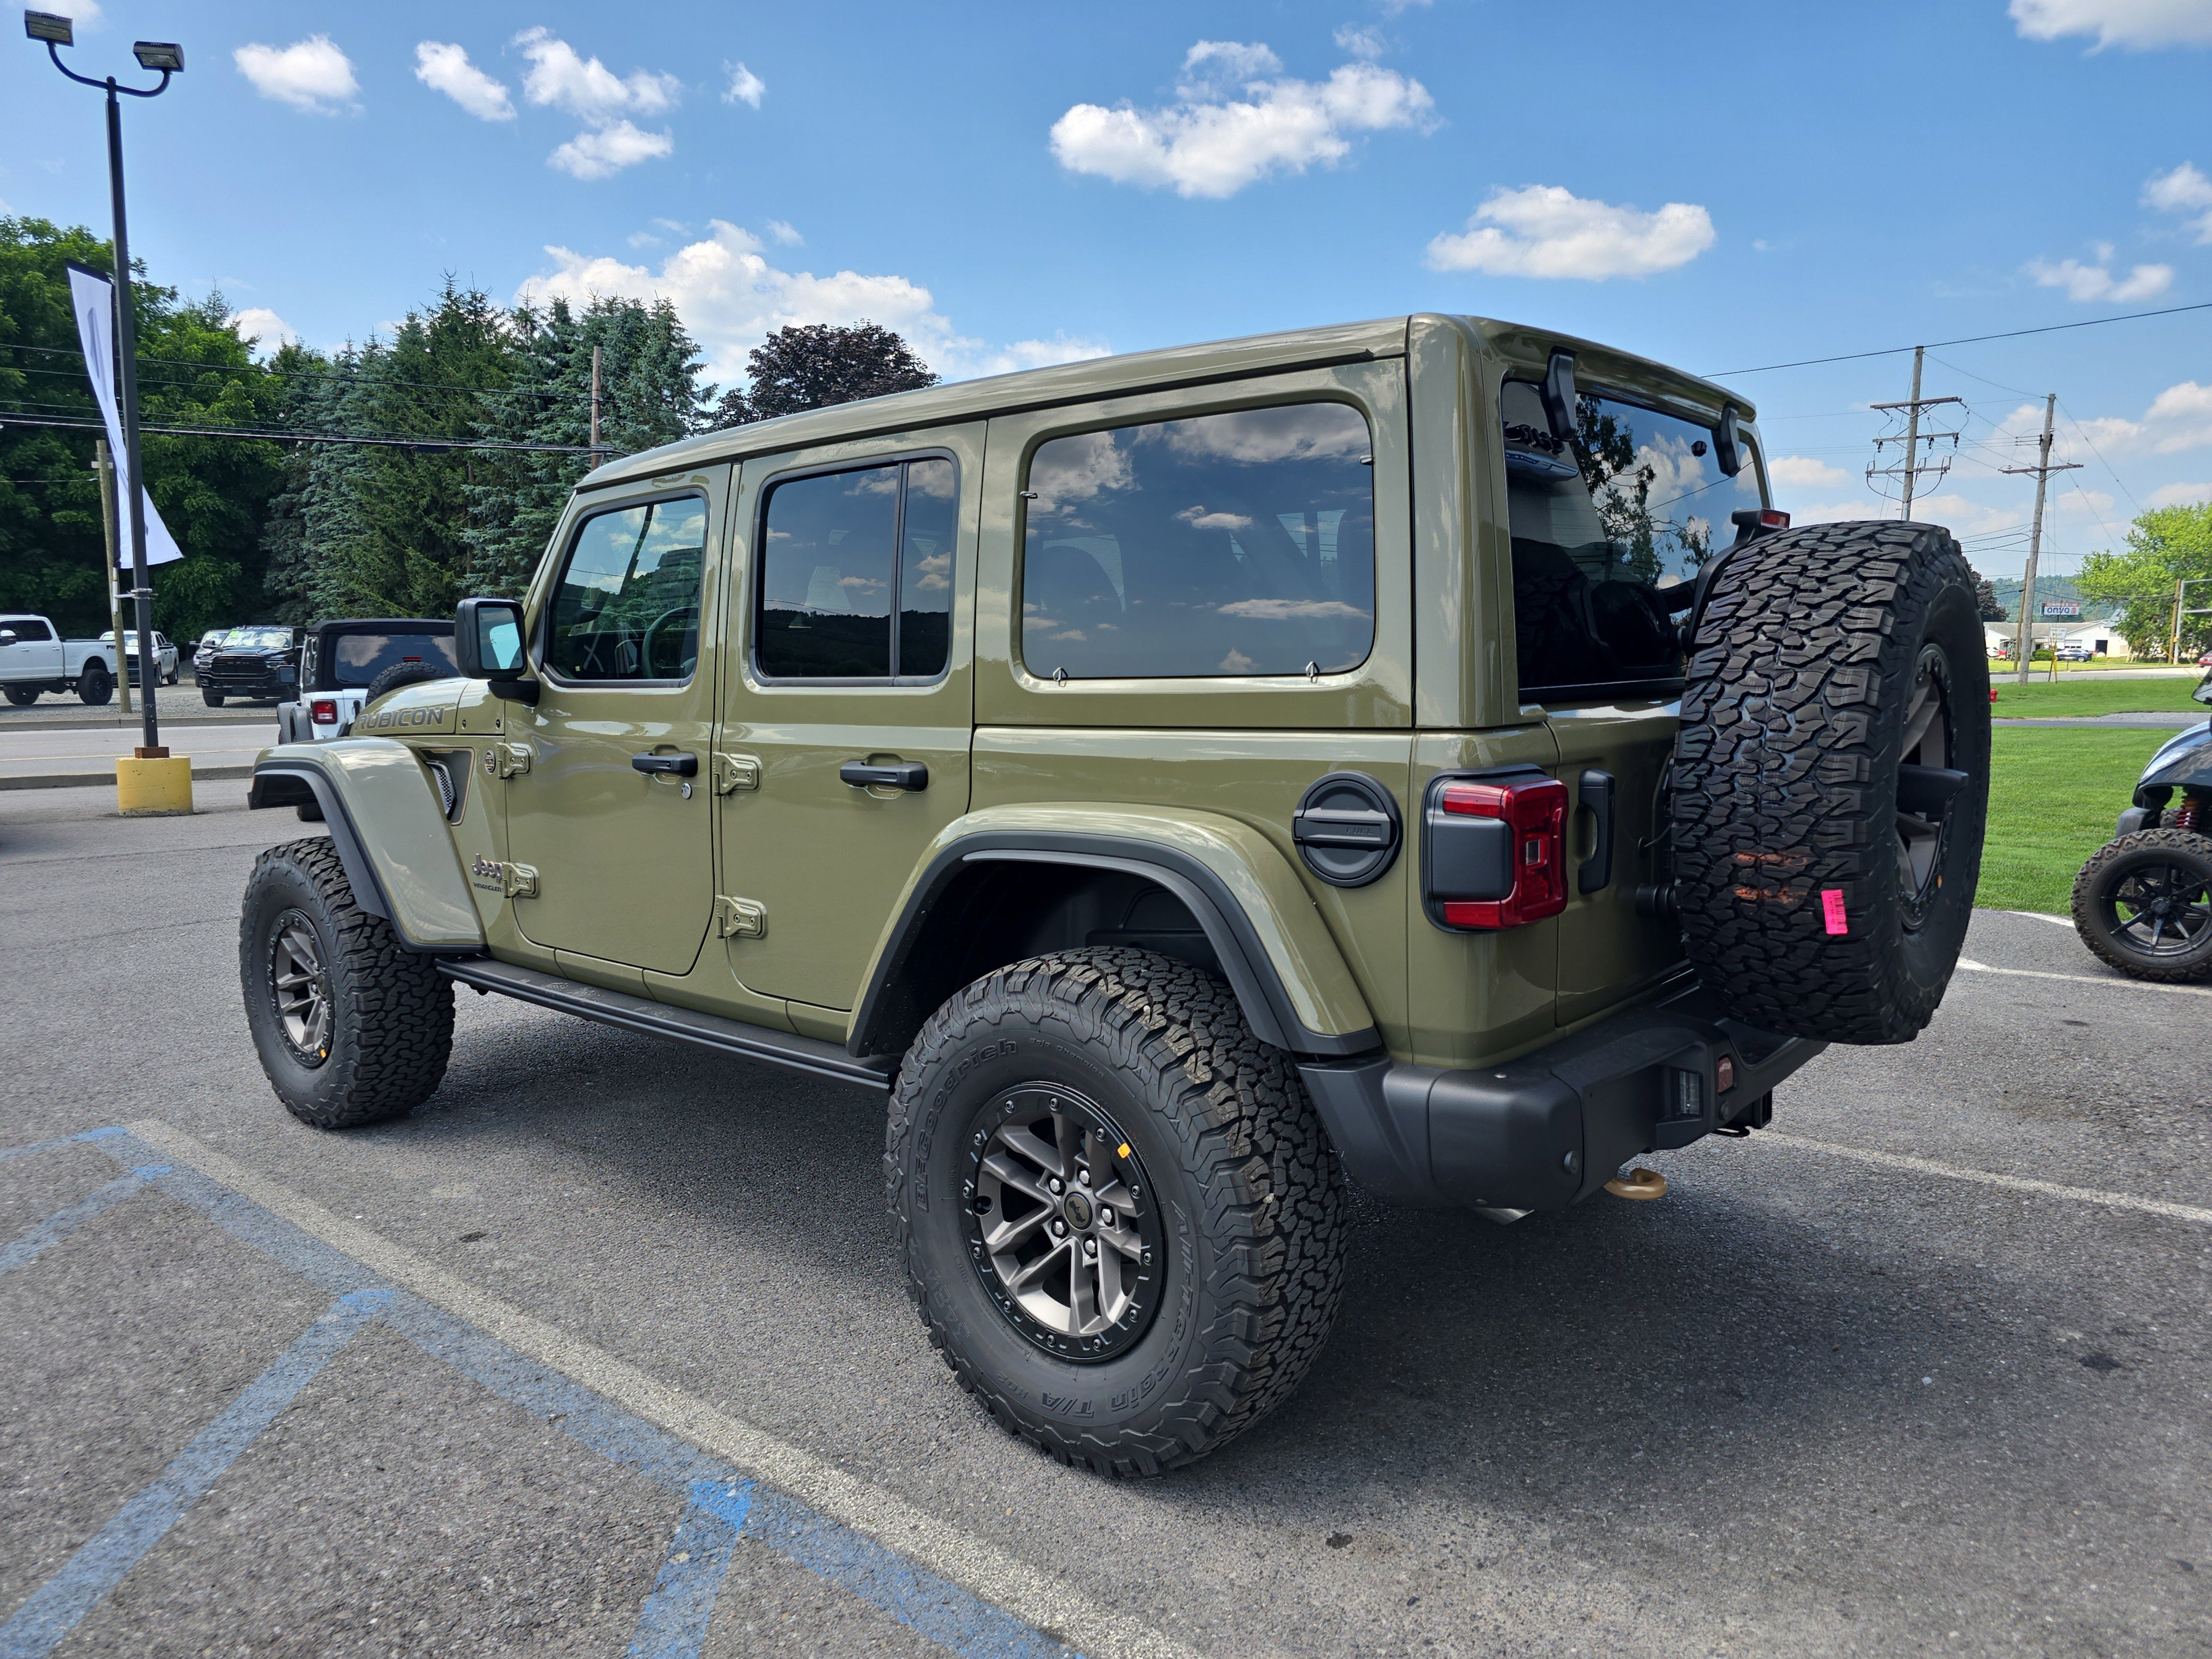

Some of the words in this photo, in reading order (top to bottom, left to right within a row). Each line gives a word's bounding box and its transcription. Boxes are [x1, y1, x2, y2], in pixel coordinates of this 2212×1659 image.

[355, 707, 445, 730] RUBICON
[472, 853, 503, 884] Jeep
[473, 882, 502, 892] WRANGLER
[915, 1038, 1018, 1213] BFGoodrich
